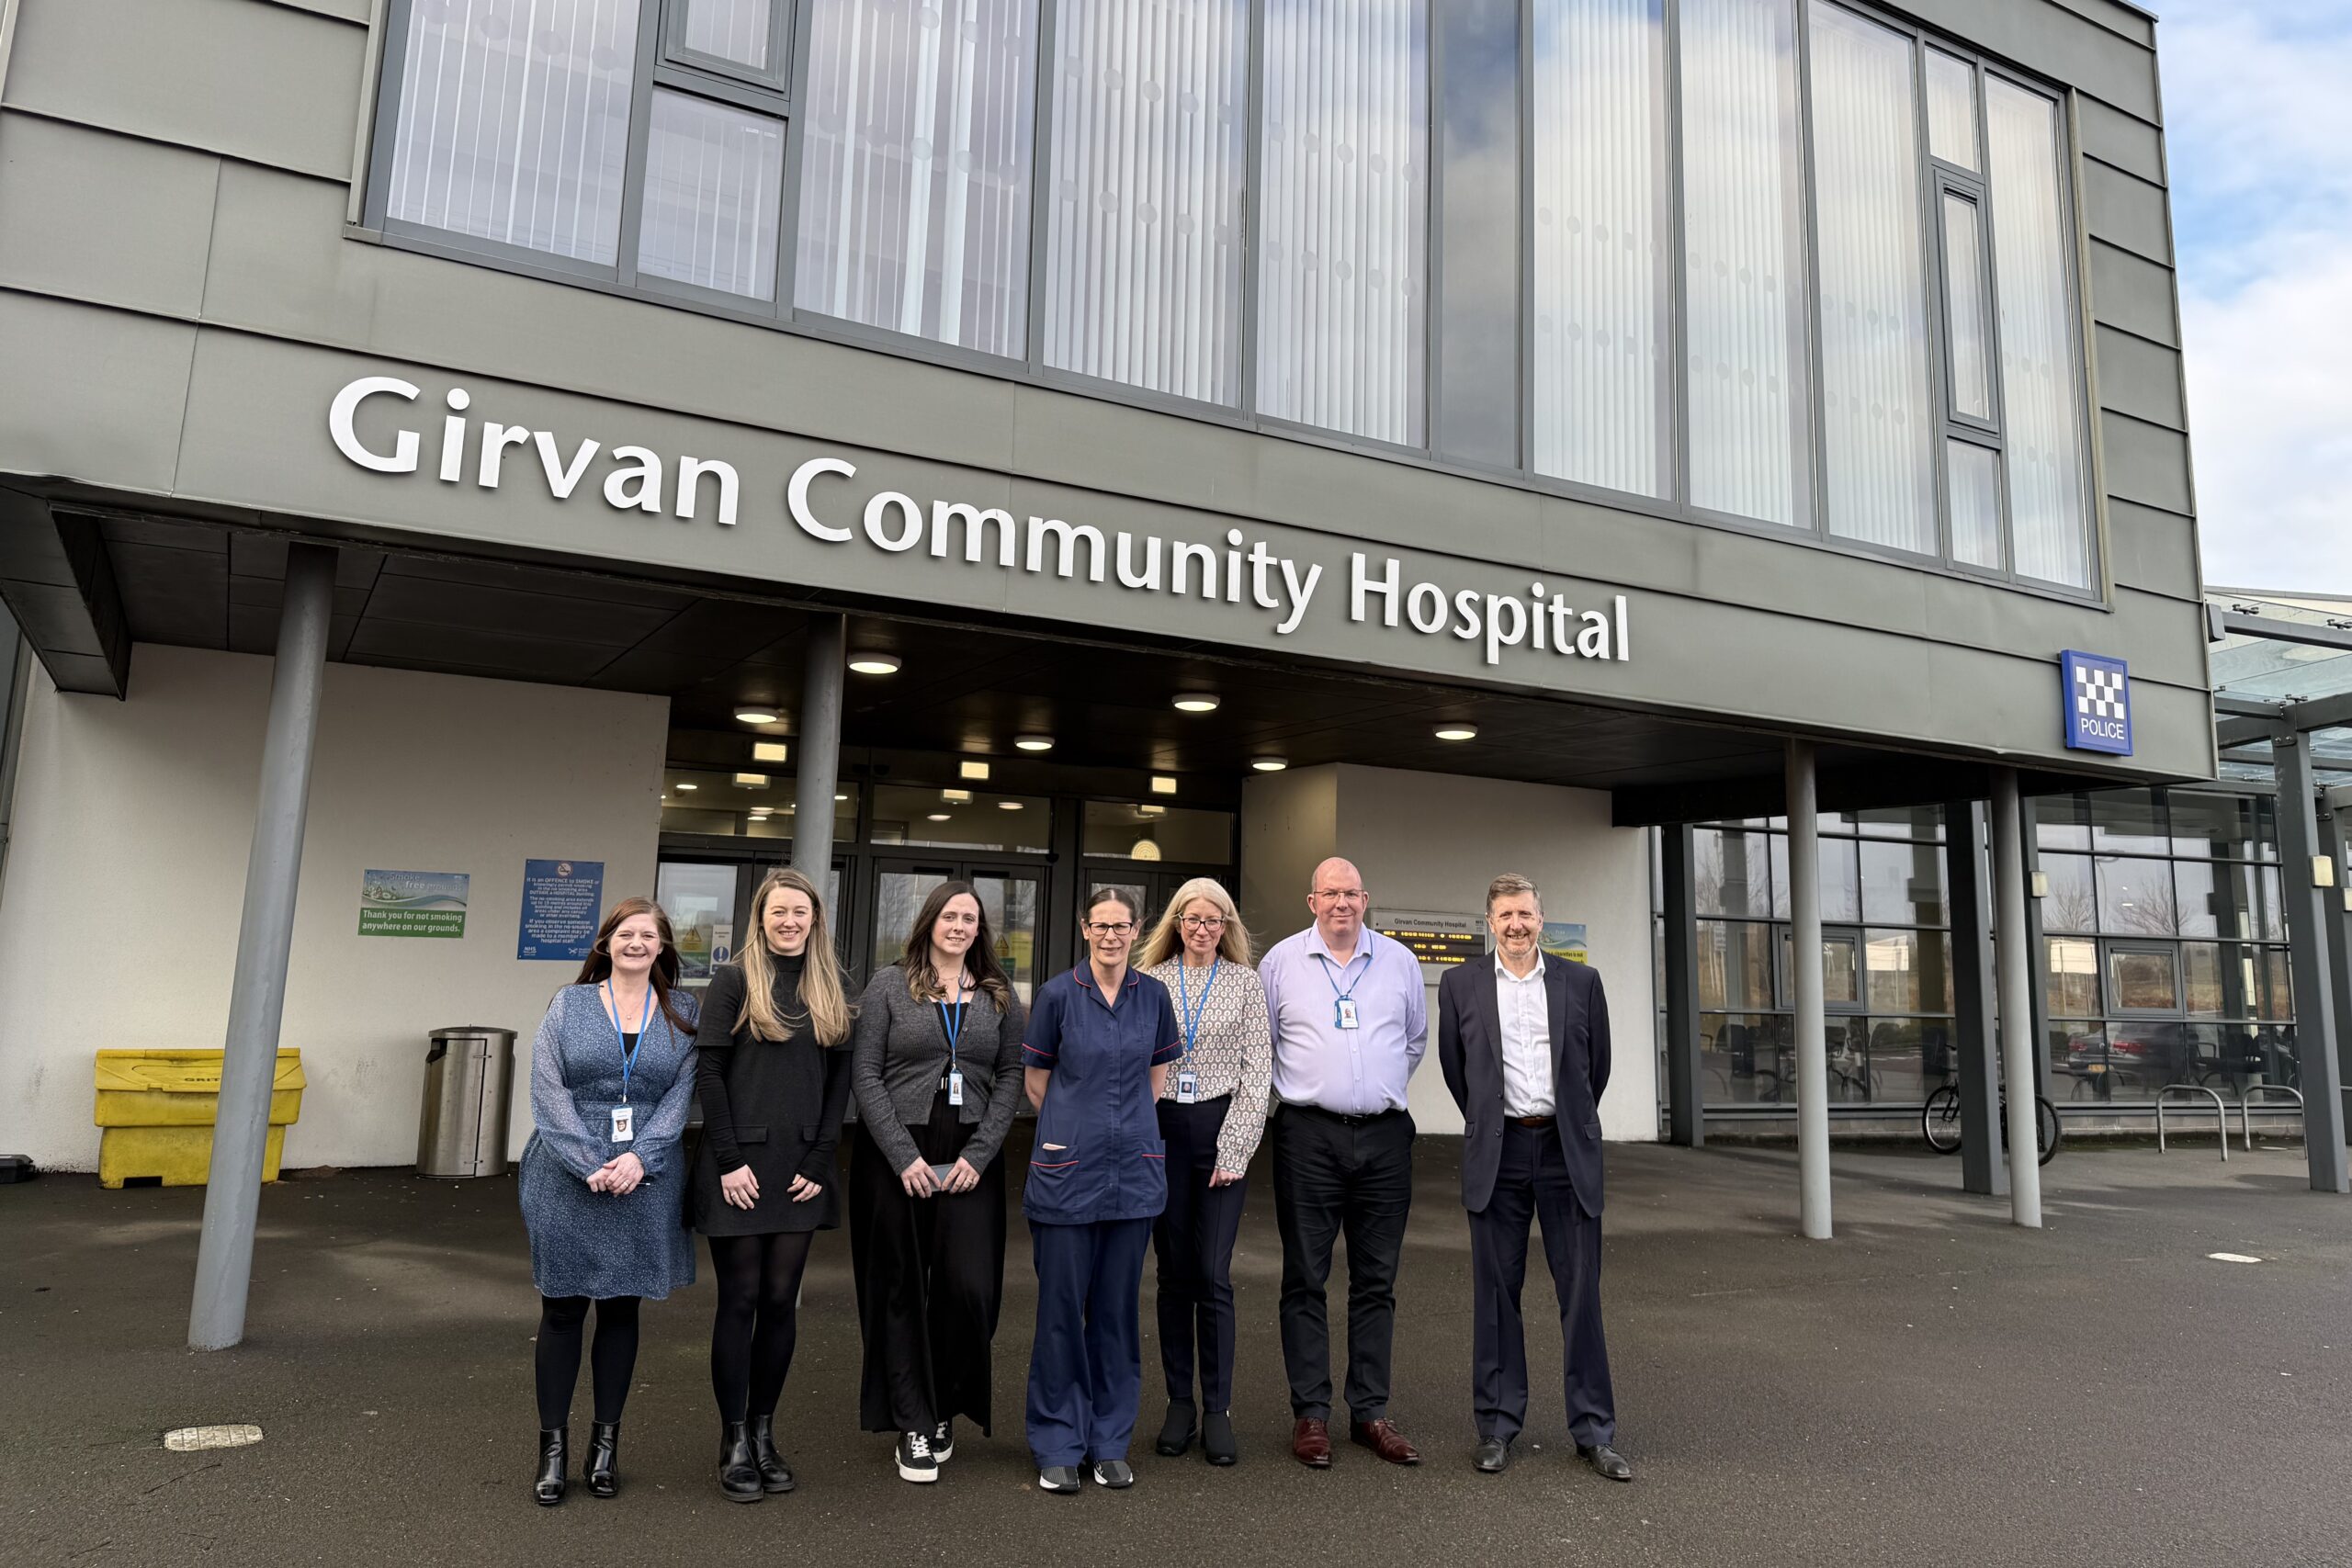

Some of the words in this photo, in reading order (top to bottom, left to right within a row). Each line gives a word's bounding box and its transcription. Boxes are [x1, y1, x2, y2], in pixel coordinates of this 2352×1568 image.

[329, 376, 740, 527] Girvan
[786, 457, 1324, 636] Community
[1351, 553, 1631, 665] Hospital
[2081, 718, 2125, 739] POLICE
[405, 881, 425, 889] free
[364, 910, 387, 919] Thank
[389, 913, 402, 921] you
[404, 911, 414, 919] for
[431, 913, 462, 923] smoking
[363, 922, 401, 931] anywhere
[428, 924, 460, 933] grounds.
[1414, 919, 1443, 928] Community
